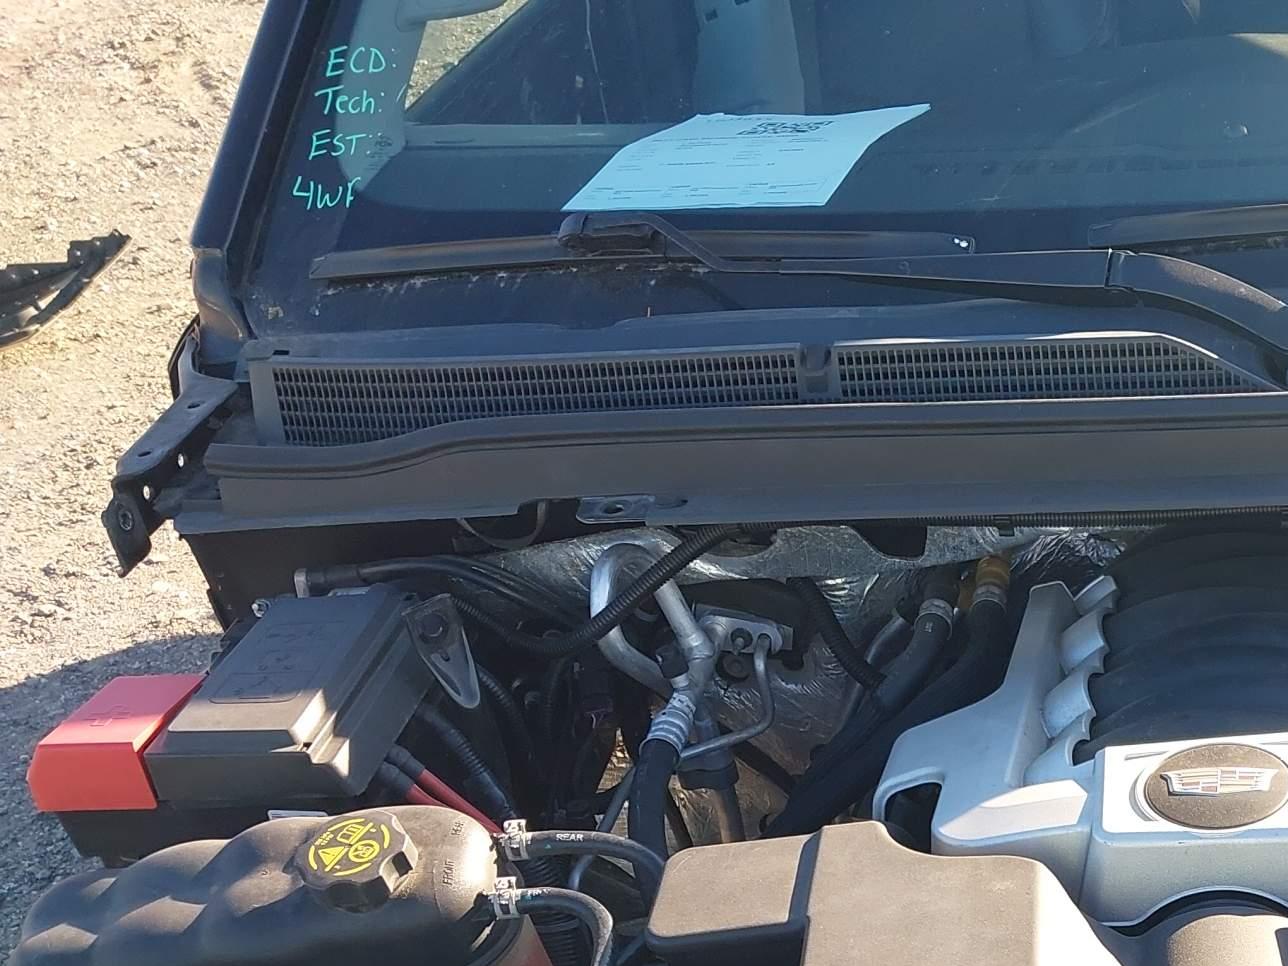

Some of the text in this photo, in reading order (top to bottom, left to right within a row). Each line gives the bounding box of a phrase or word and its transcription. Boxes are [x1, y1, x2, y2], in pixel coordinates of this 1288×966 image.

[326, 45, 397, 77] ECD:
[314, 84, 385, 114] Tech:
[555, 833, 584, 842] REAR
